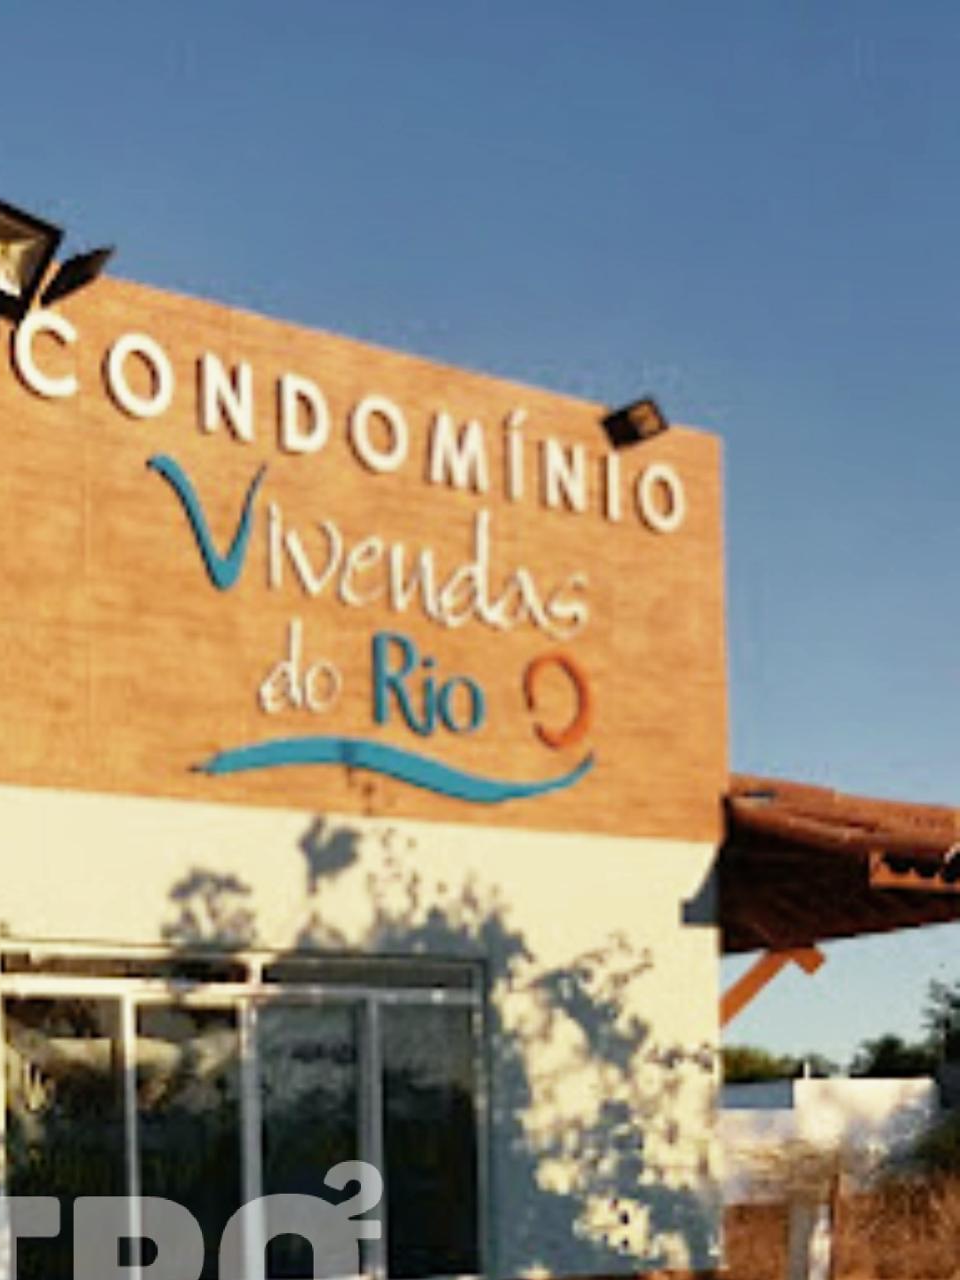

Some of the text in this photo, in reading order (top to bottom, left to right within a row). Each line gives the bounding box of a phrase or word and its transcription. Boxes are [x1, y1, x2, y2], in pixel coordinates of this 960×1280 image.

[12, 309, 688, 533] CONDOMÍNIO
[146, 453, 591, 636] Vivendas
[259, 618, 485, 737] do Rio
